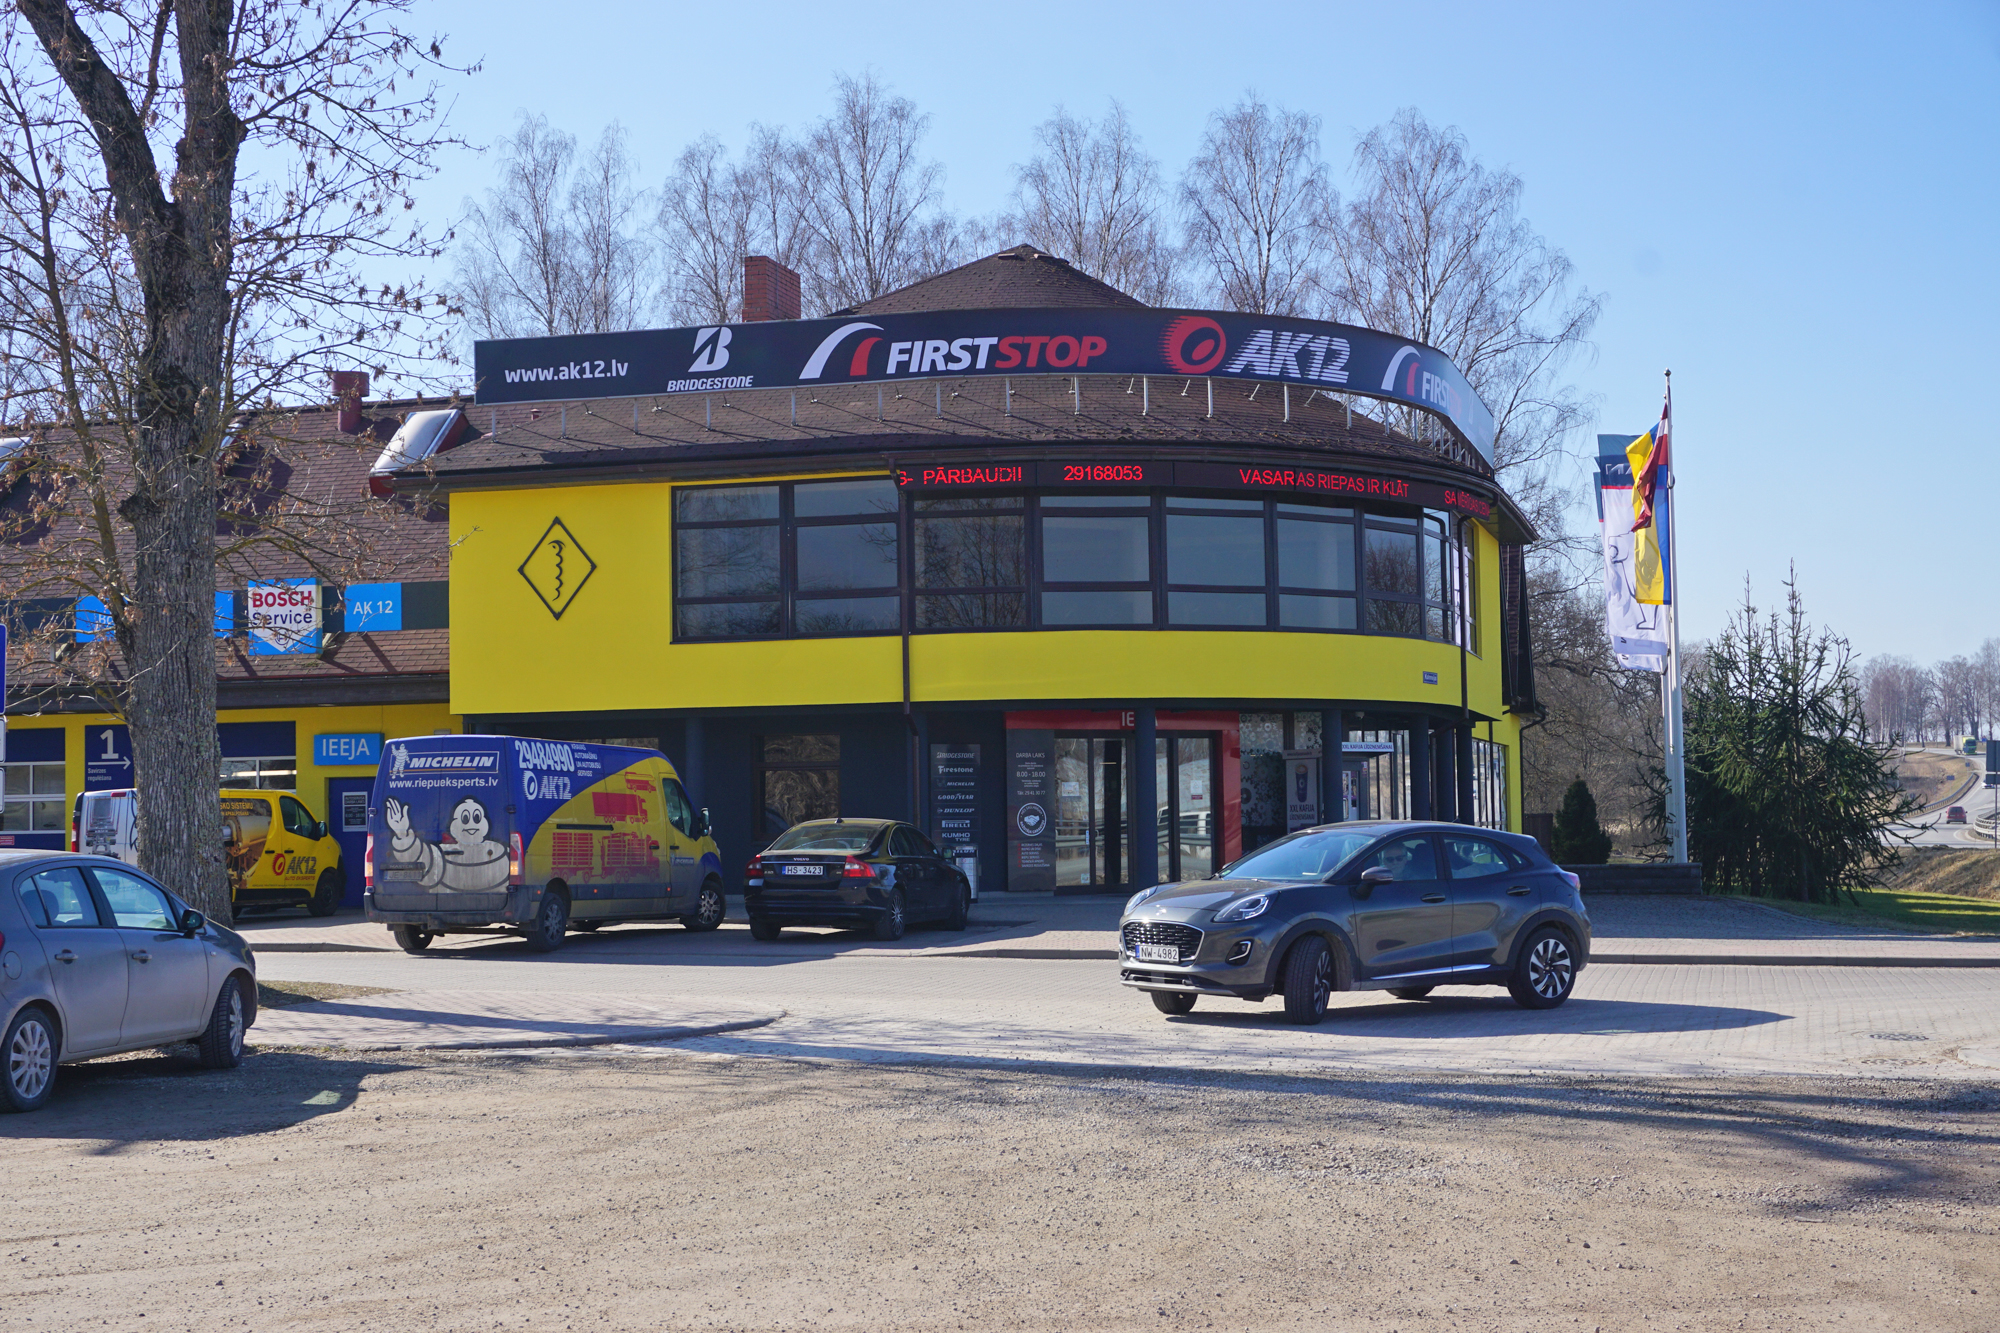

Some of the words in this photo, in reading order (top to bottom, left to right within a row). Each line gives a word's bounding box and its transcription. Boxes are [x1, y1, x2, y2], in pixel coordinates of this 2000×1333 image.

[886, 335, 1108, 374] FIRSTSTOP
[1222, 329, 1350, 383] AK12
[504, 358, 629, 383] www.ak12.lv
[666, 375, 754, 392] BRIDGESTONE
[923, 466, 1022, 486] PĀRBAUDI!
[1063, 465, 1143, 481] 29168053
[1317, 473, 1365, 493] RIEPAS
[1367, 478, 1379, 494] IR
[1382, 479, 1409, 498] KLĀT
[252, 591, 313, 608] BOSCH
[353, 601, 373, 615] AK
[377, 600, 393, 614] 12
[252, 611, 312, 625] Service
[100, 729, 119, 760] 1
[322, 738, 370, 761] IEEJA
[409, 756, 495, 768] MICHELIN
[515, 740, 575, 772] 29484990
[938, 765, 974, 774] Firestone
[389, 776, 498, 789] www.riepueksperts.lv
[538, 775, 572, 800] AK12
[1290, 804, 1298, 812] XXL
[1299, 804, 1315, 812] KAFIJA
[941, 820, 970, 828] PIRELLI
[286, 856, 317, 875] AK12
[787, 866, 822, 874] HS-3423
[1141, 947, 1177, 960] NW-4982
